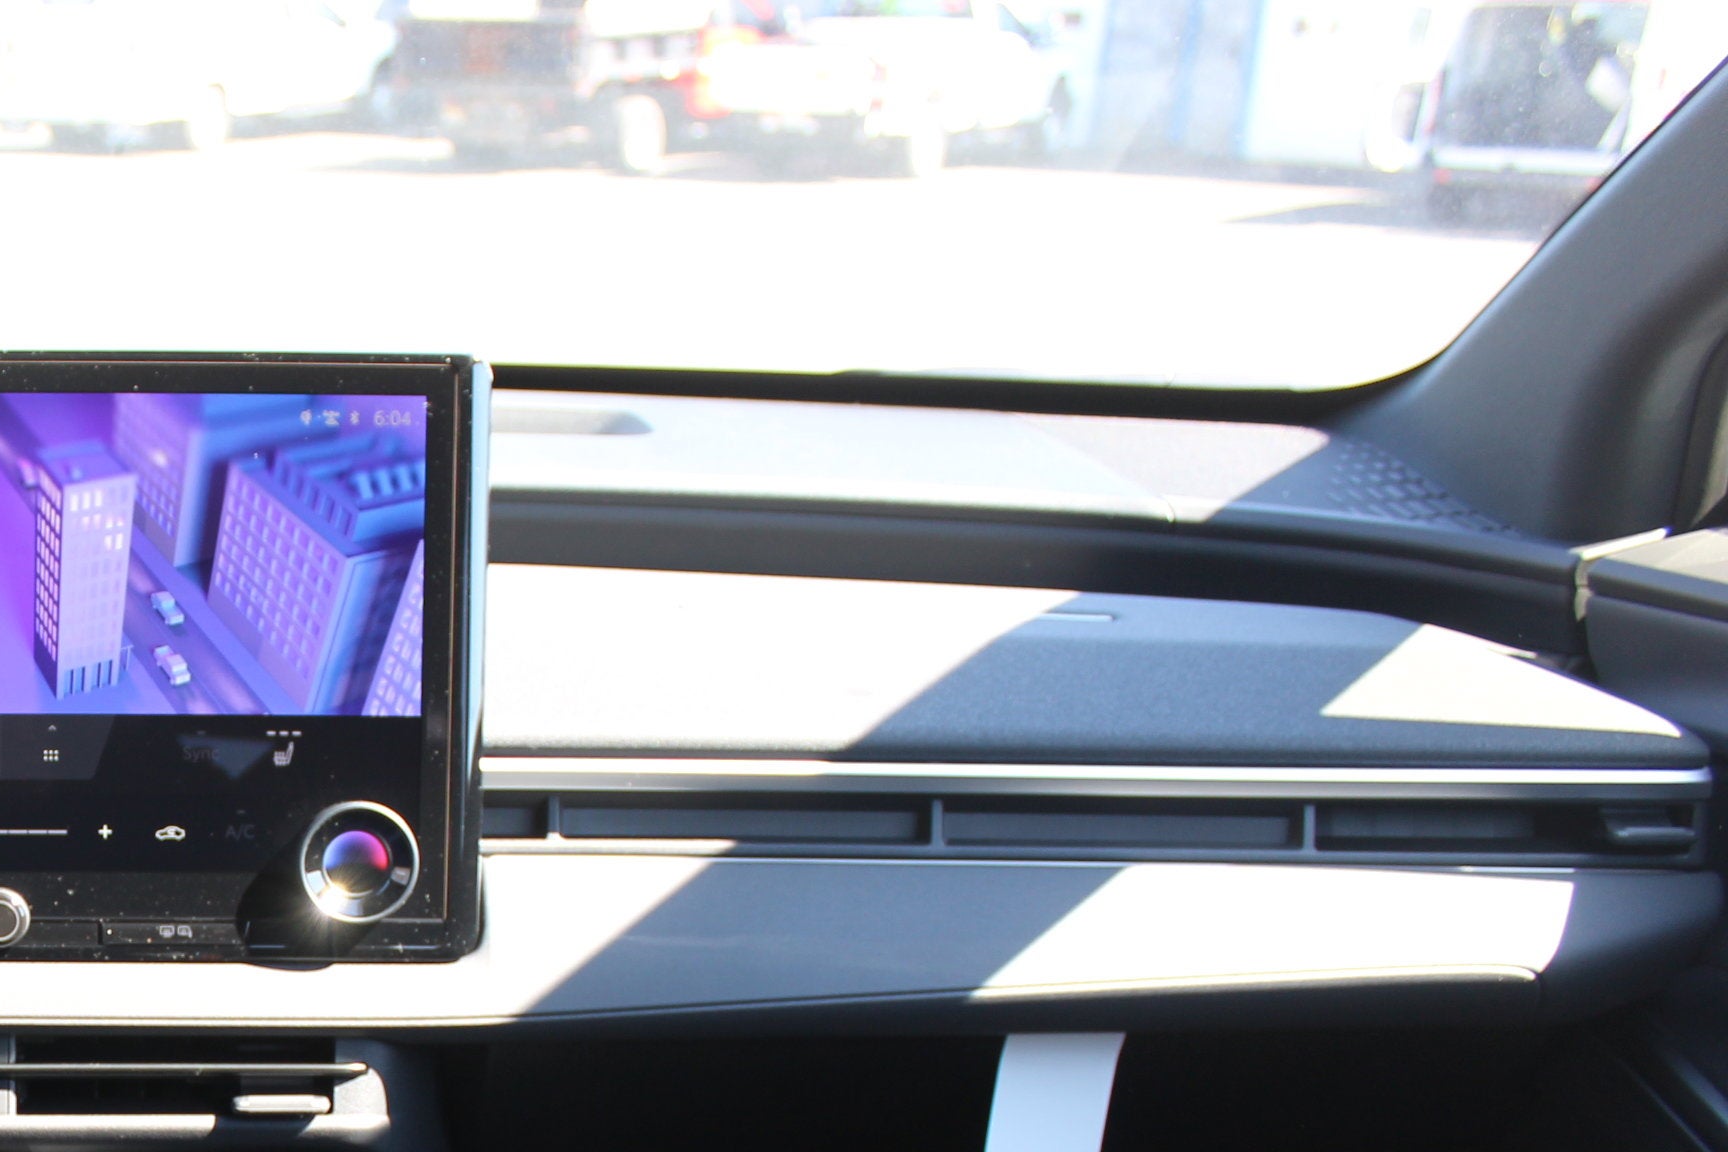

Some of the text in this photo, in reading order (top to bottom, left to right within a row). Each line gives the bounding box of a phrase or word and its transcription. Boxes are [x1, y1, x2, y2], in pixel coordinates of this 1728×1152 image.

[373, 410, 412, 427] 6:04
[183, 747, 221, 763] Sync
[225, 824, 256, 840] A/C
